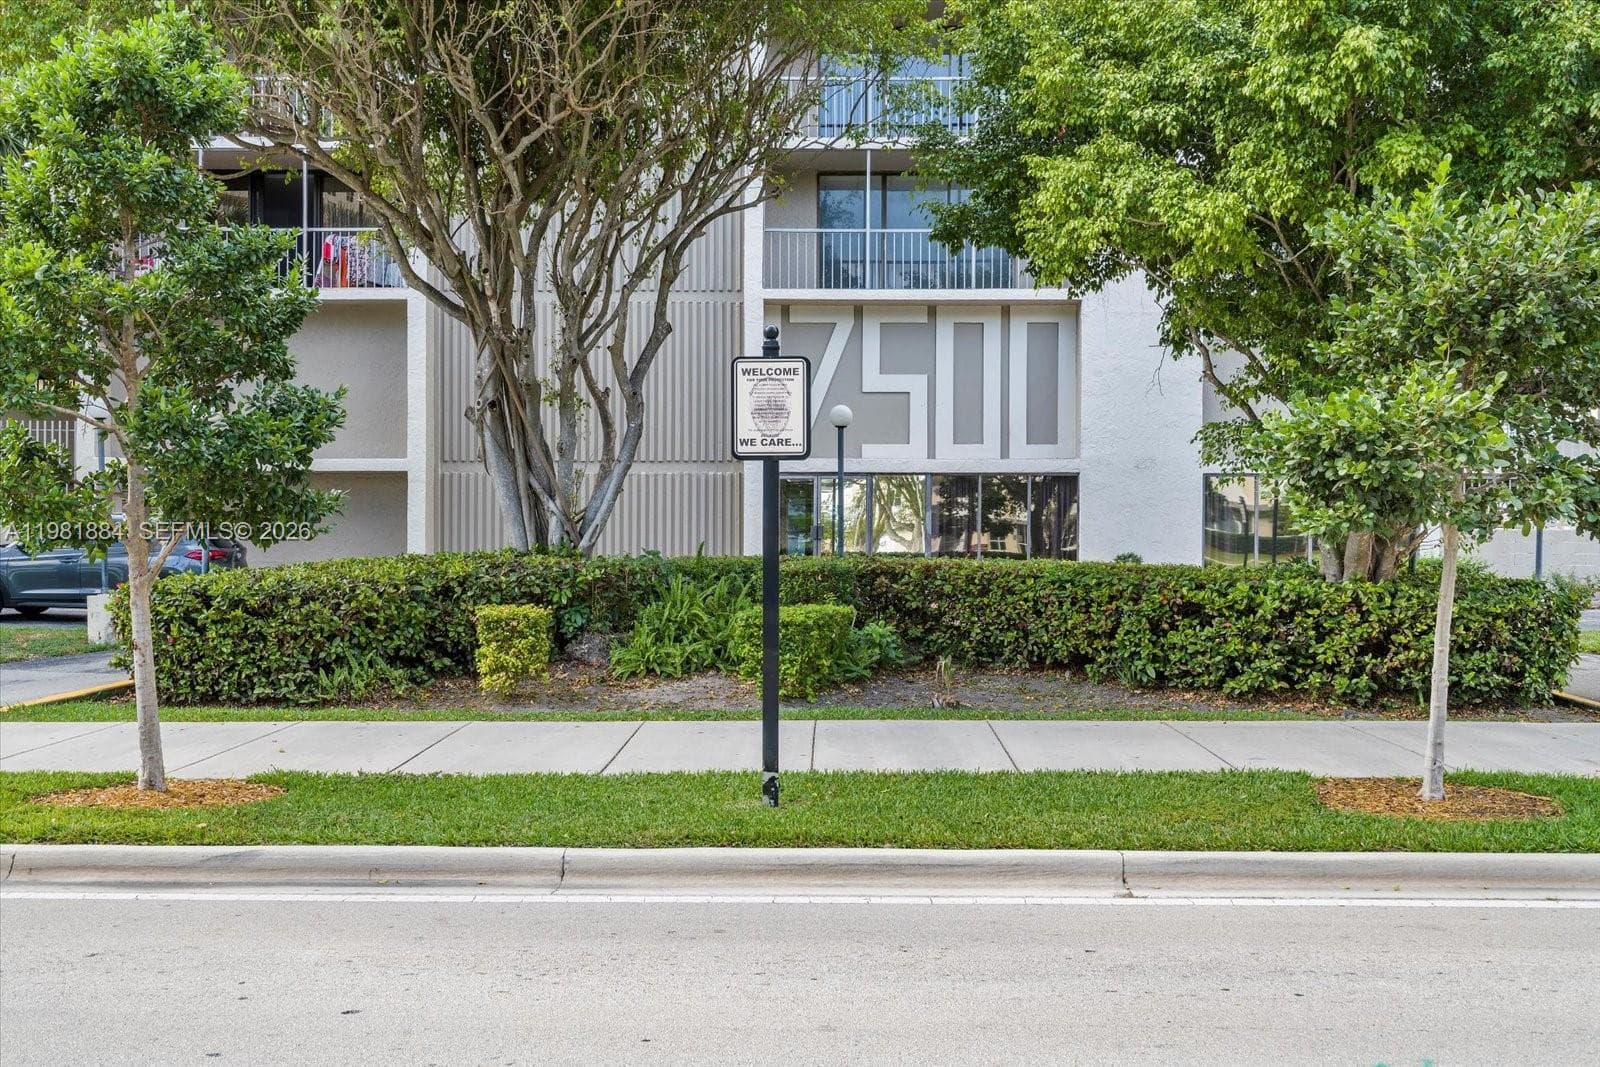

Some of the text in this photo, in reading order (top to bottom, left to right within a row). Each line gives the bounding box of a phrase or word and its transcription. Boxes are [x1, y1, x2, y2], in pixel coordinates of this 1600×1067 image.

[741, 367, 800, 377] WELCOME
[764, 304, 1078, 459] 7500
[739, 438, 802, 447] WE CARE...
